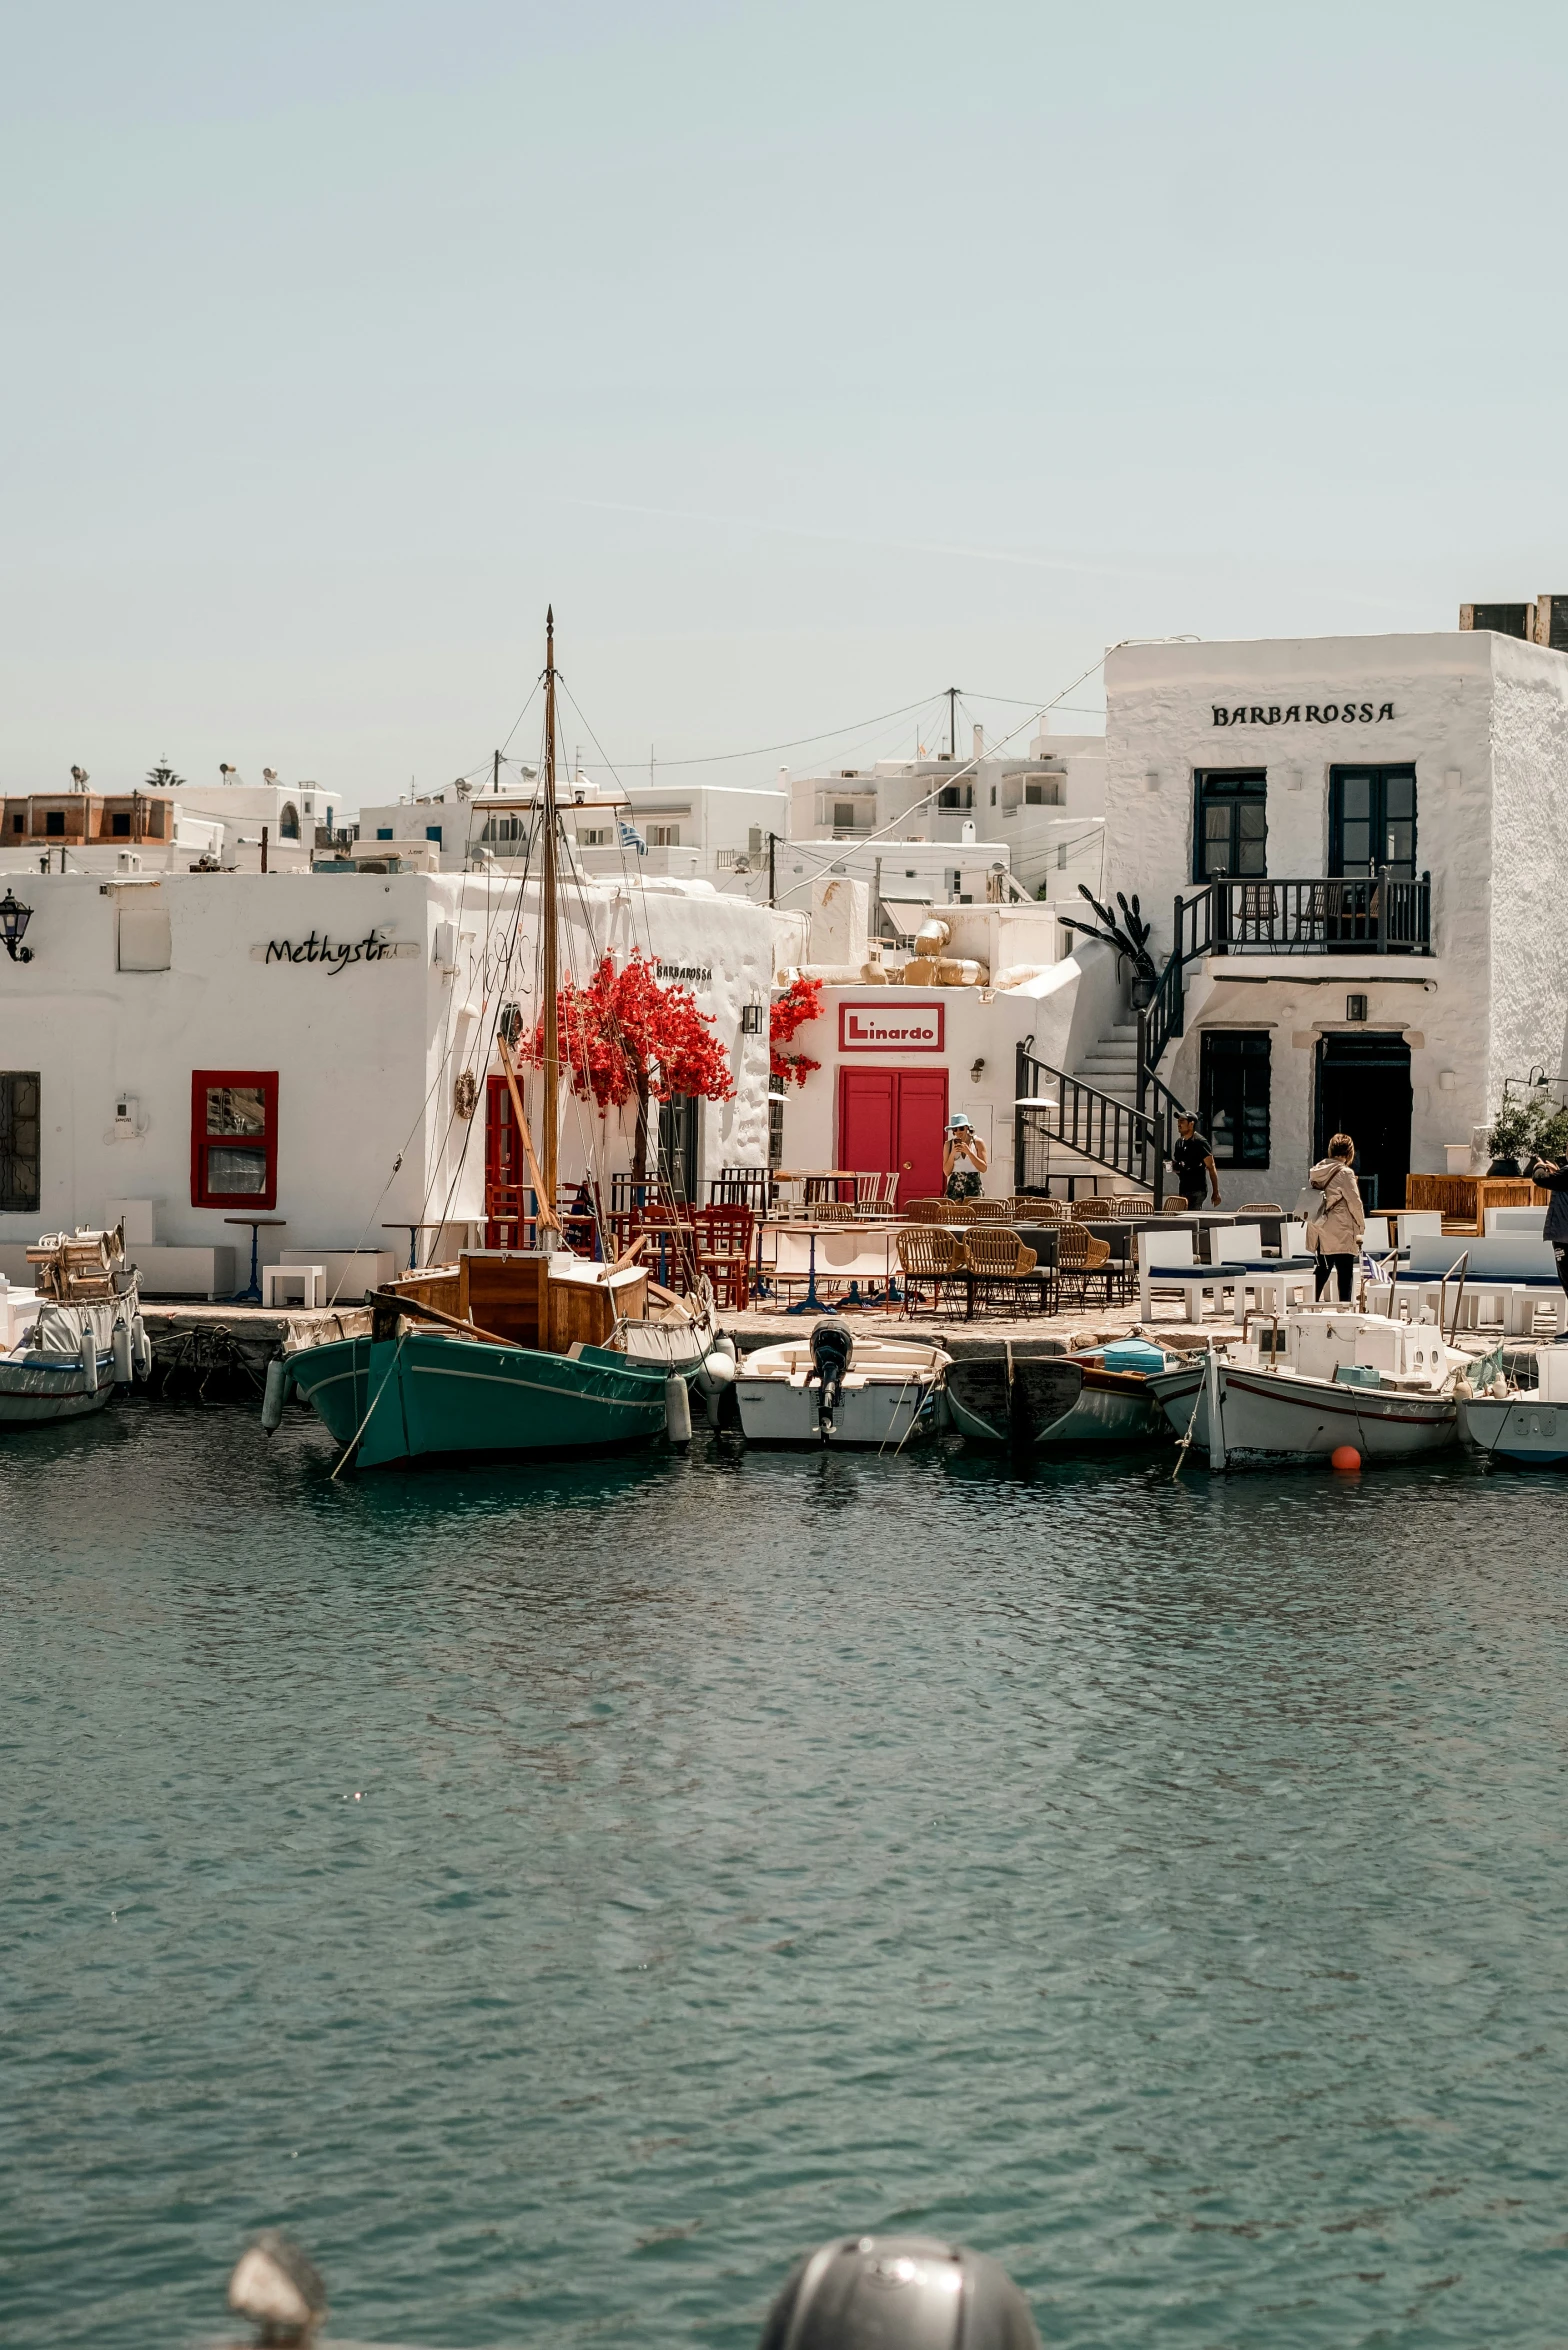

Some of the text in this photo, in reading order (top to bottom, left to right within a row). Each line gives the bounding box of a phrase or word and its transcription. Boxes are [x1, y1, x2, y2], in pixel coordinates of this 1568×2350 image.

[1211, 703, 1395, 727] BARBAROSSA
[656, 963, 713, 981] BARBAROSSA
[849, 1015, 934, 1040] Linardo
